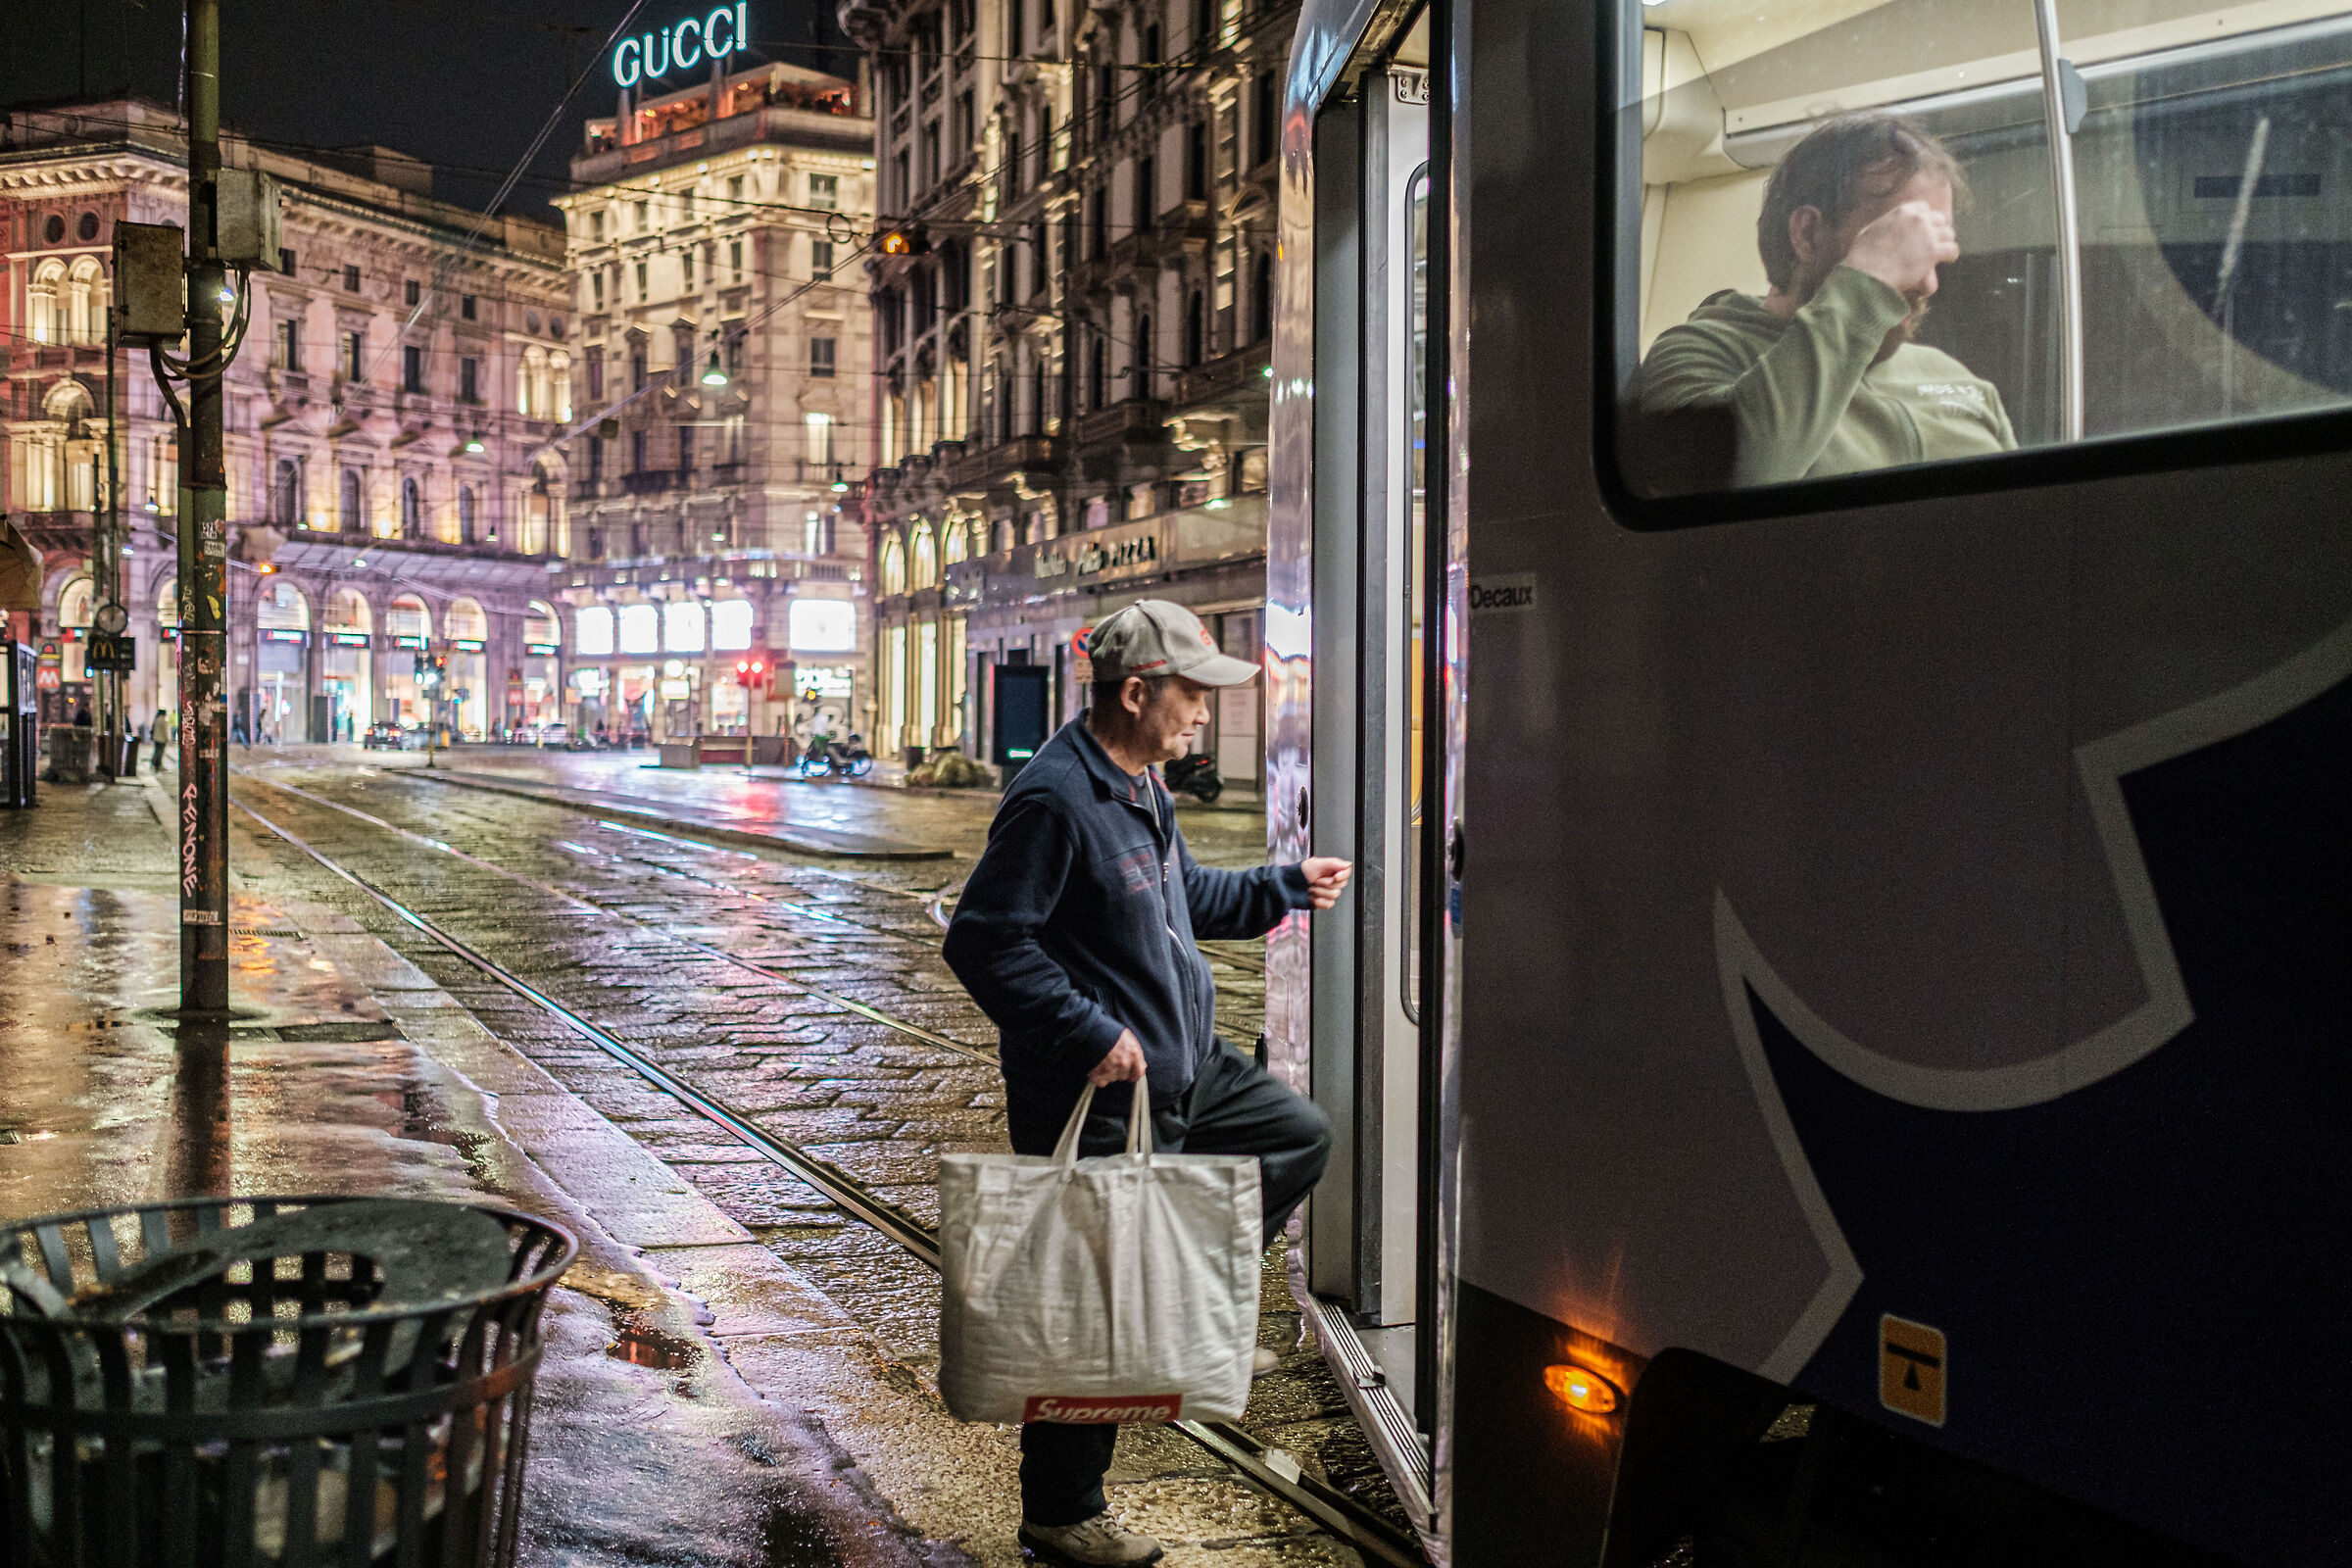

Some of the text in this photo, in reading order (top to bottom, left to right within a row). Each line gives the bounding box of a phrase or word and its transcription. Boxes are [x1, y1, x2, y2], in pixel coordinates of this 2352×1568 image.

[612, 1, 747, 87] GUCCI
[1470, 584, 1533, 610] Decaux
[1033, 1398, 1172, 1421] Supreme
